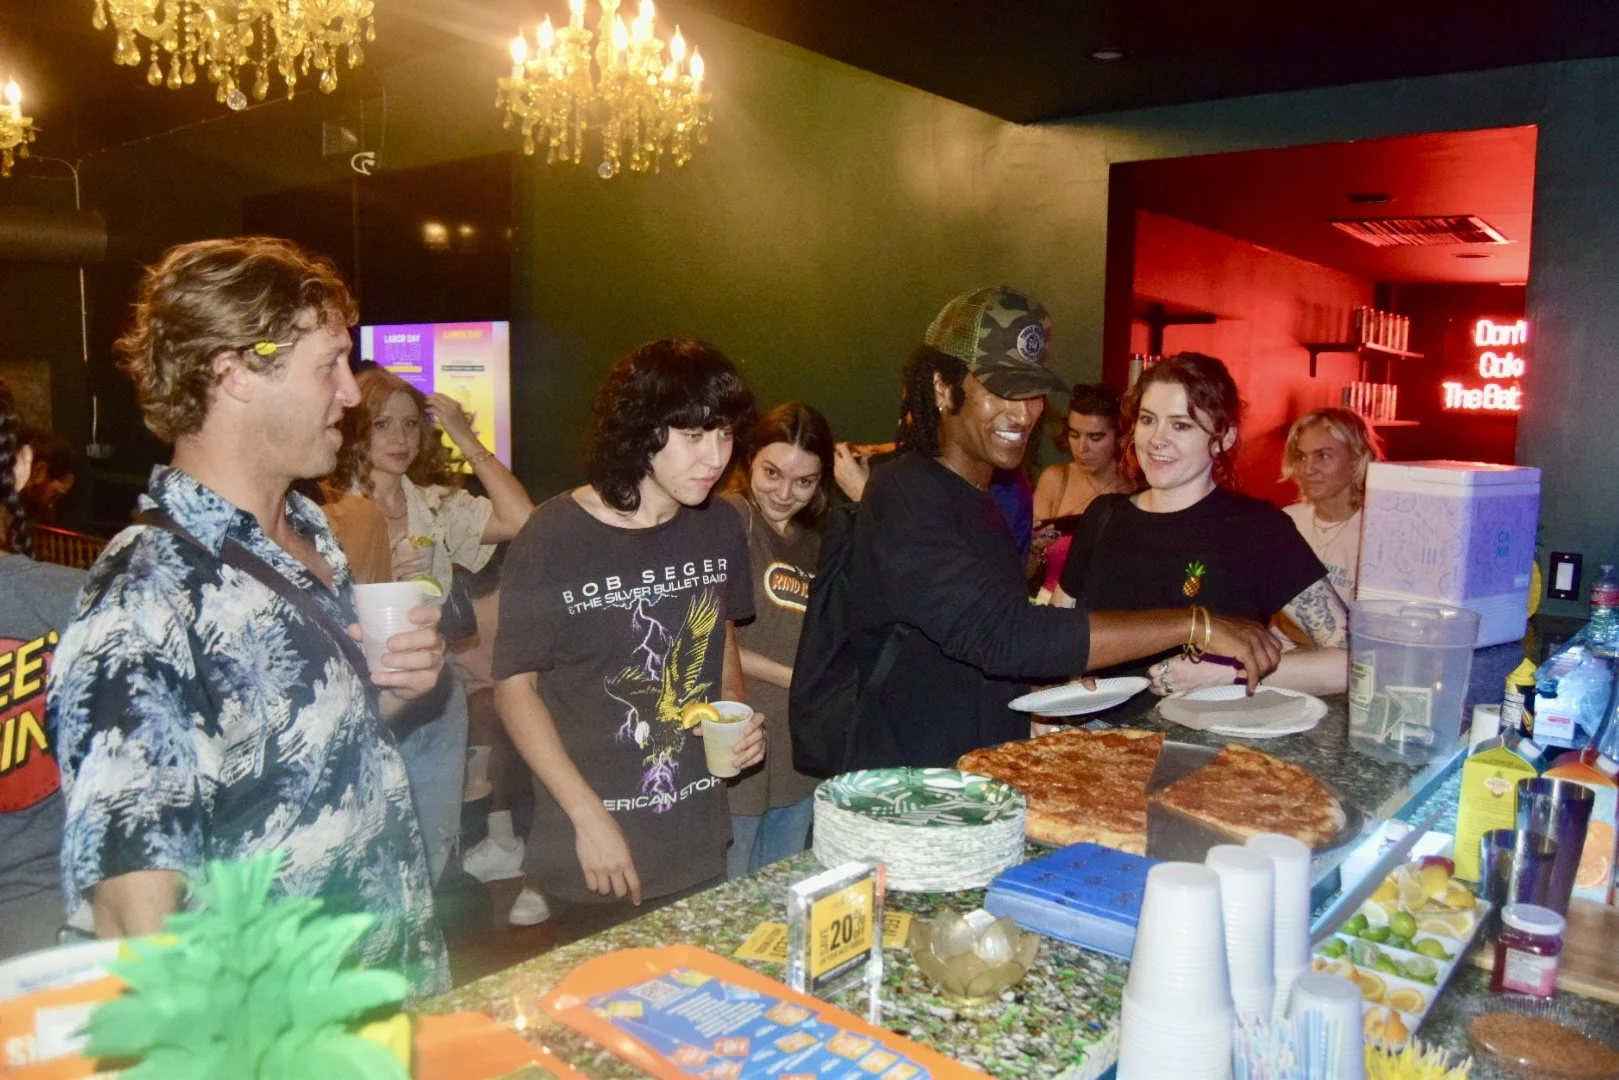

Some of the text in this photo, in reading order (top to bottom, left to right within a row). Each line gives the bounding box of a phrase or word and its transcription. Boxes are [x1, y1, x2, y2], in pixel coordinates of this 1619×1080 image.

[383, 333, 421, 343] LABOR DAY
[1443, 383, 1483, 408] The
[562, 558, 727, 604] BOB SEGER
[605, 586, 651, 605] SILVER
[654, 575, 699, 594] BULLET
[603, 791, 677, 811] ERICAN
